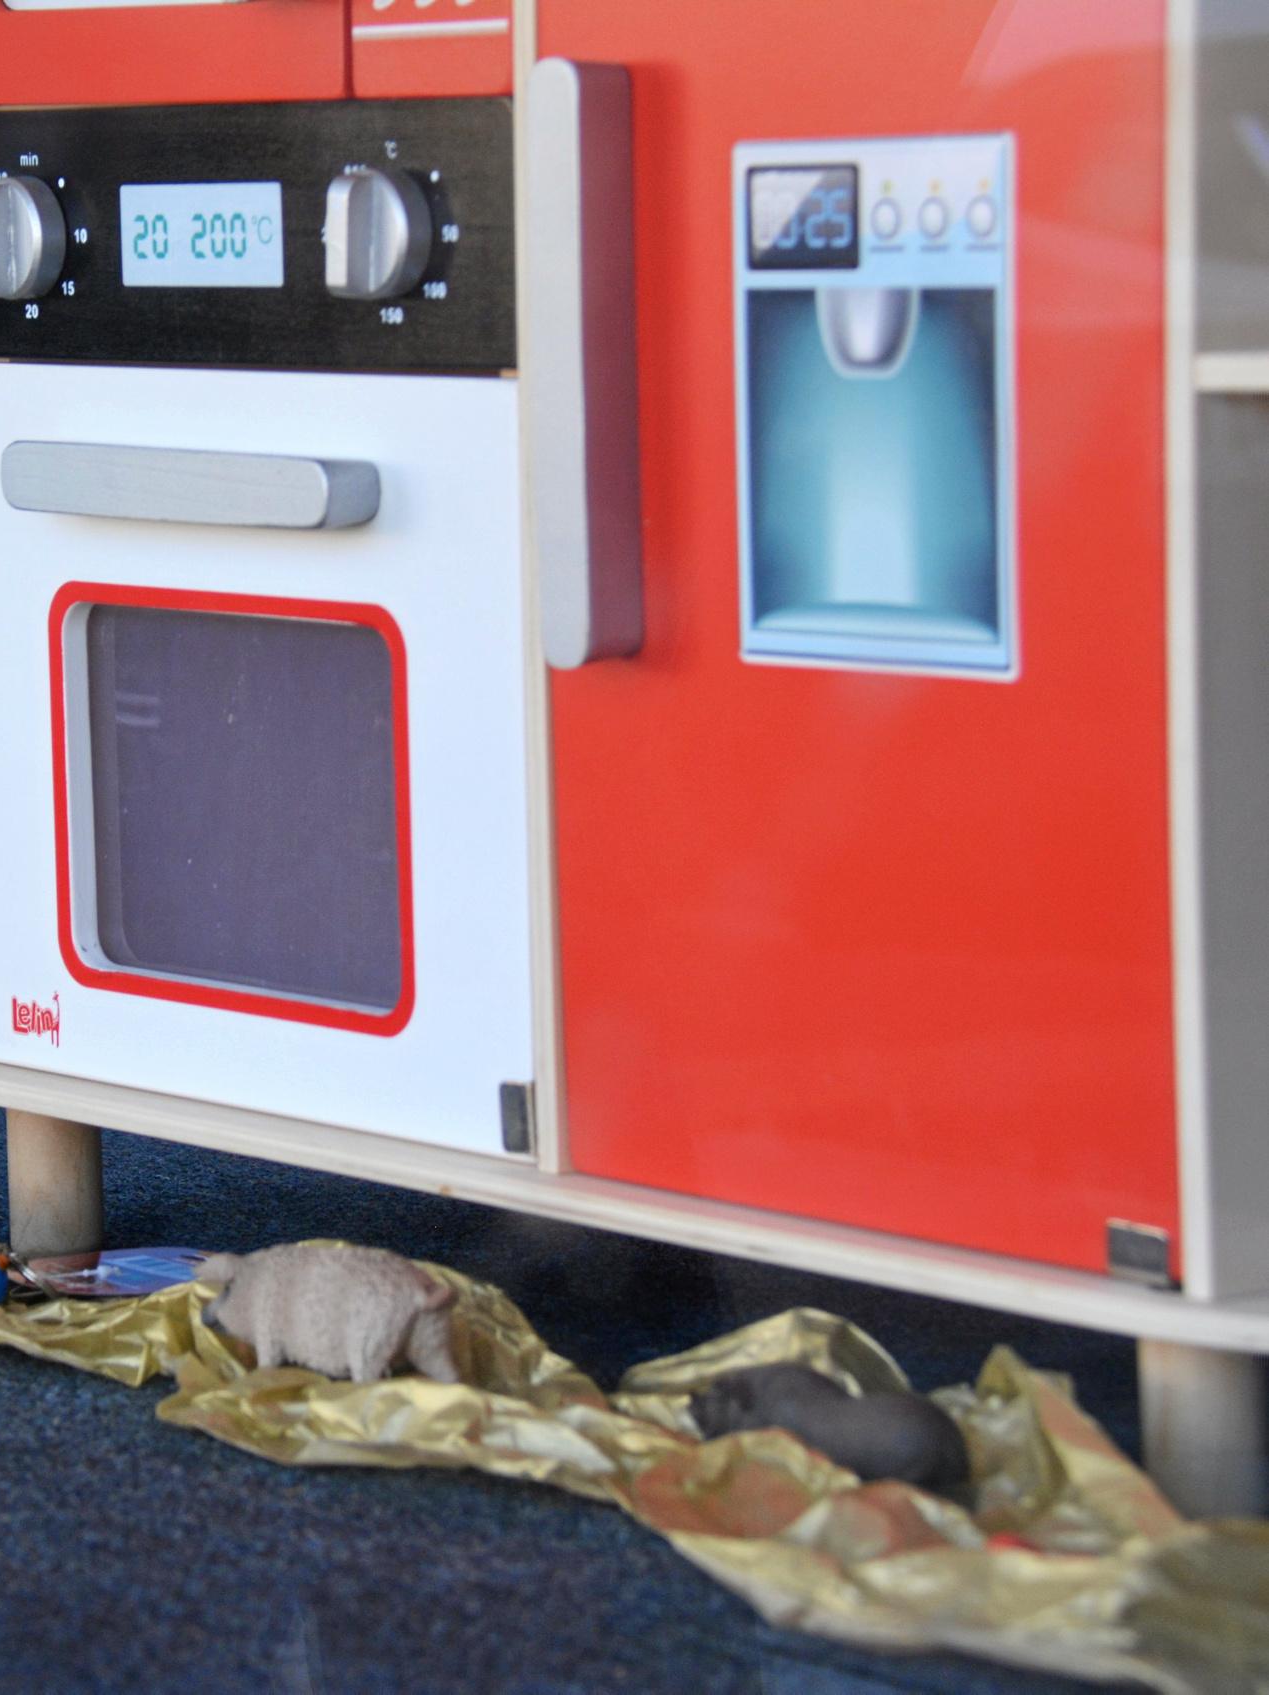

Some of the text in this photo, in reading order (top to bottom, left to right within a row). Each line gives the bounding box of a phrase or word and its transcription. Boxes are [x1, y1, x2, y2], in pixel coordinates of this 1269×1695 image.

[20, 152, 39, 167] min
[73, 227, 88, 244] 10
[133, 213, 169, 260] 20
[61, 280, 76, 296] 15
[25, 303, 39, 319] 20
